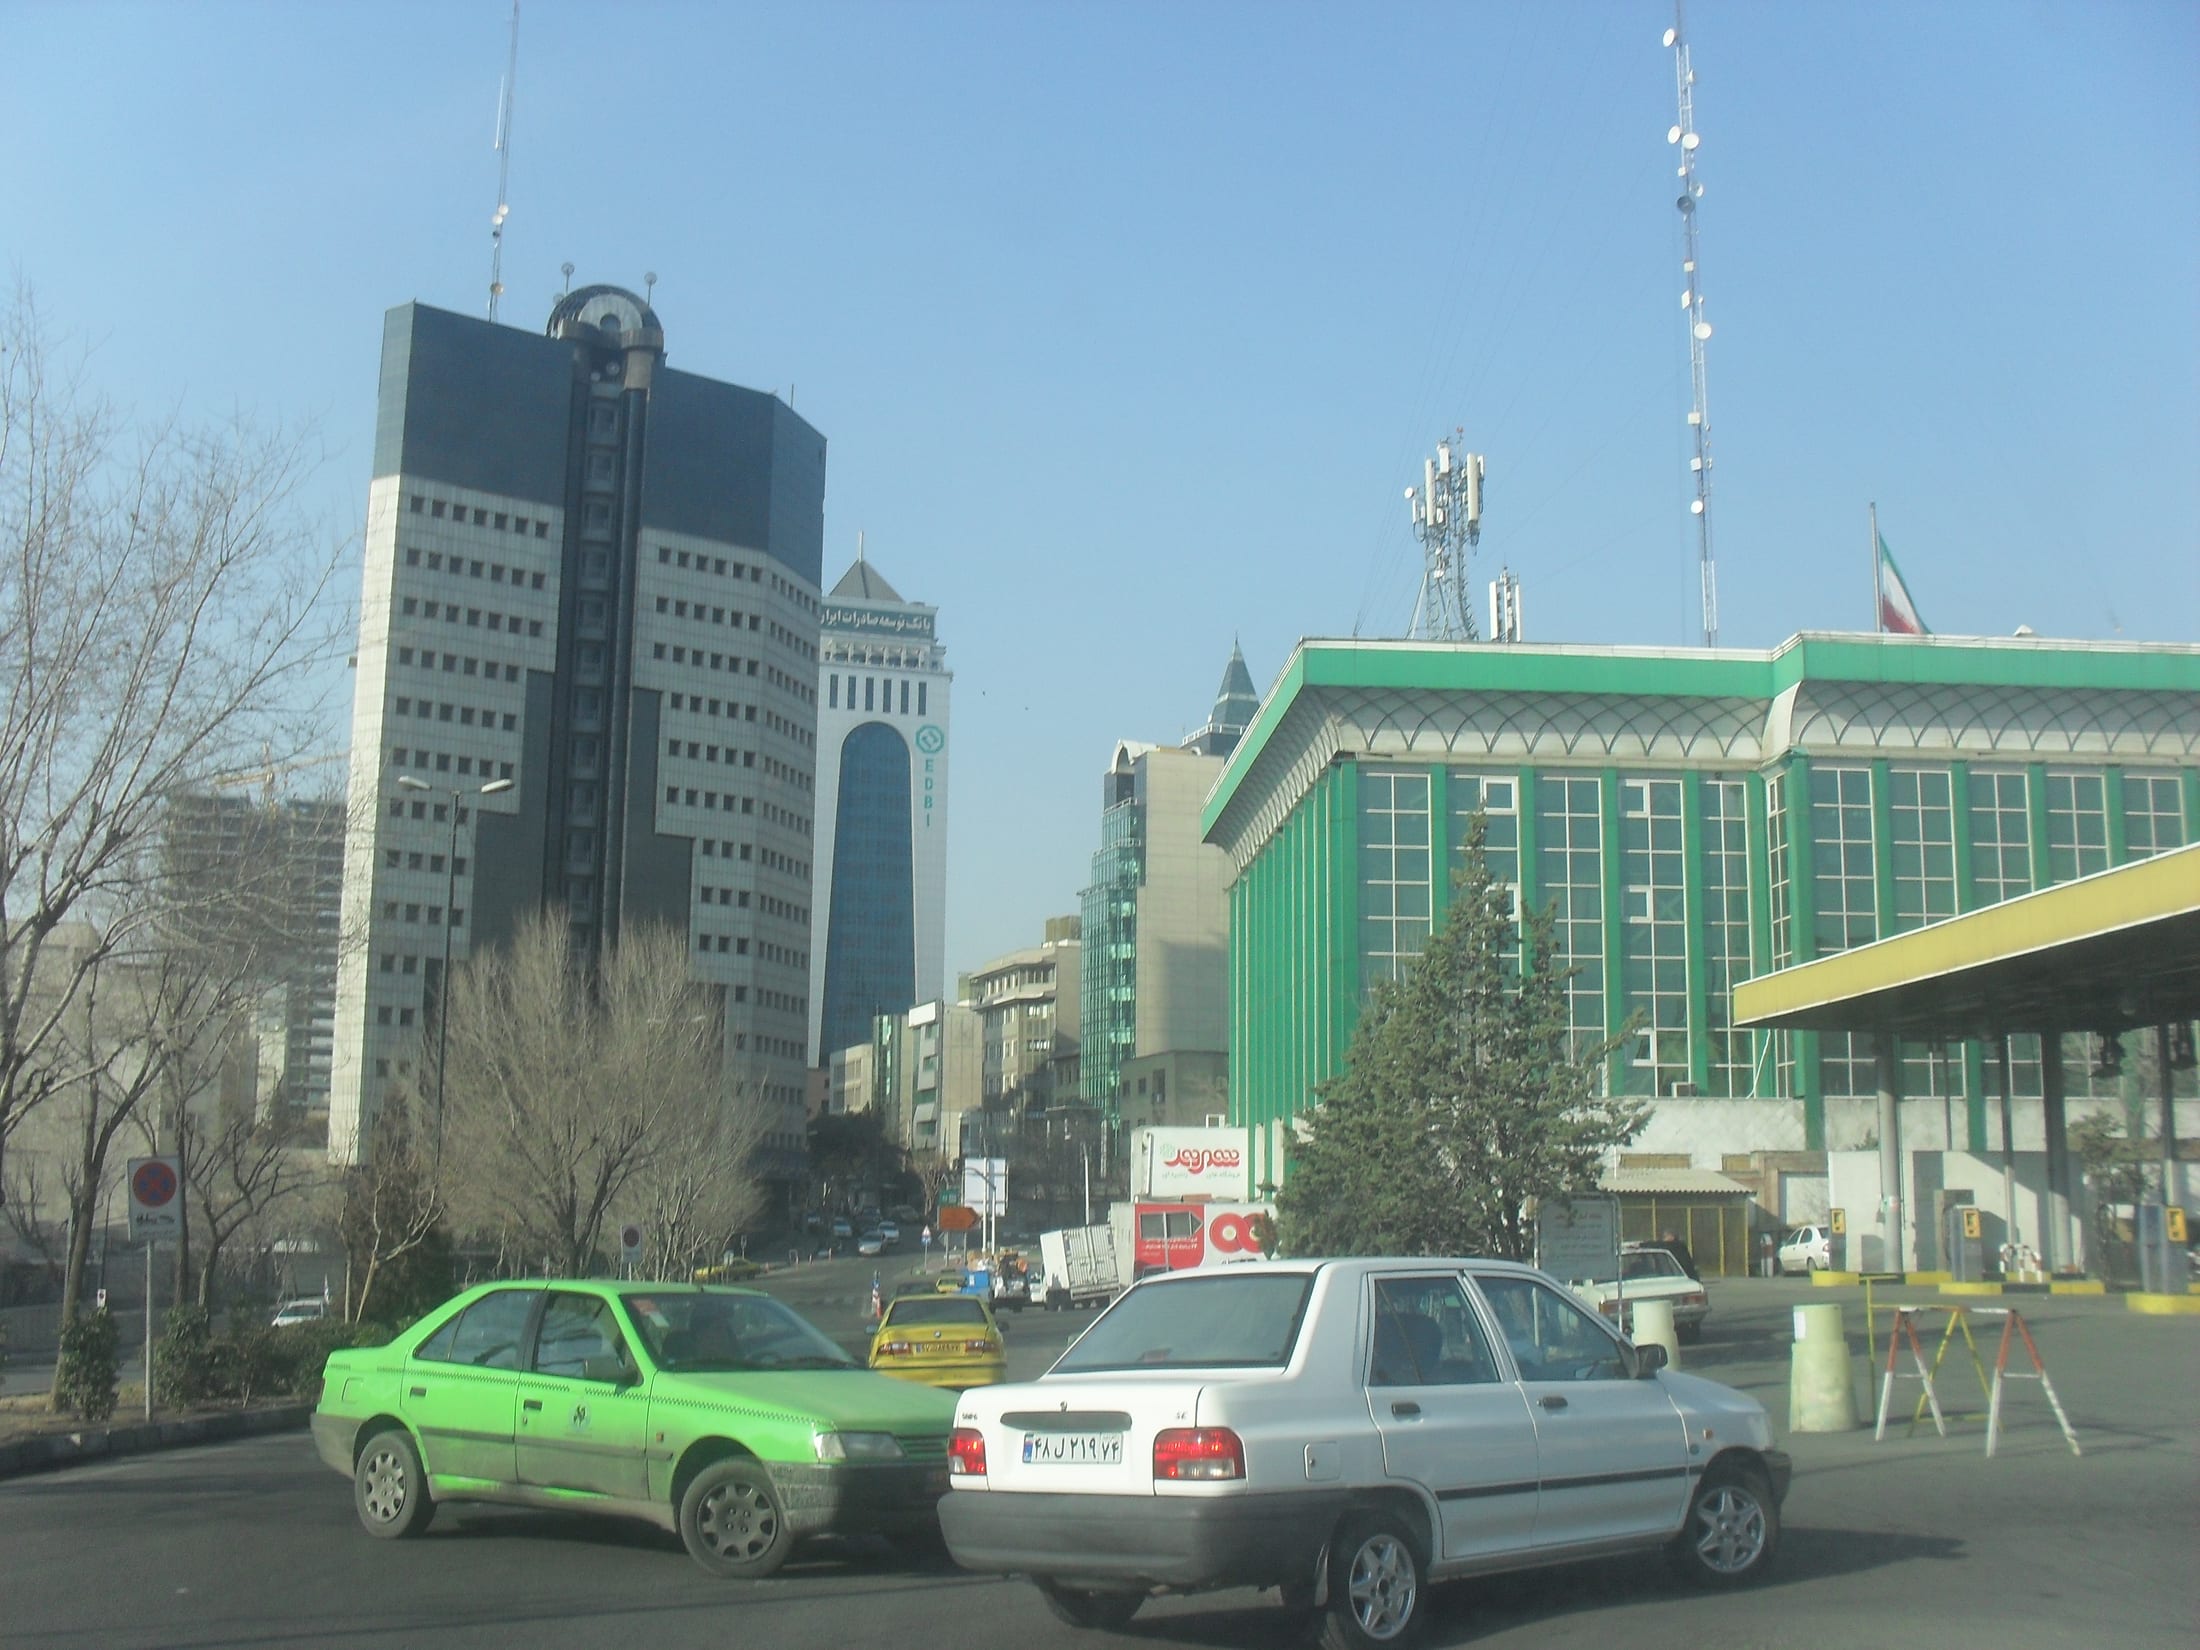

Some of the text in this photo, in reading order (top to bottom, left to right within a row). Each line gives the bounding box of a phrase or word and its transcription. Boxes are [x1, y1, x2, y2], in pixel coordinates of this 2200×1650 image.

[842, 610, 879, 628] صادرات
[879, 614, 905, 632] توسعه
[906, 616, 931, 634] بانک
[924, 759, 933, 828] EDBI
